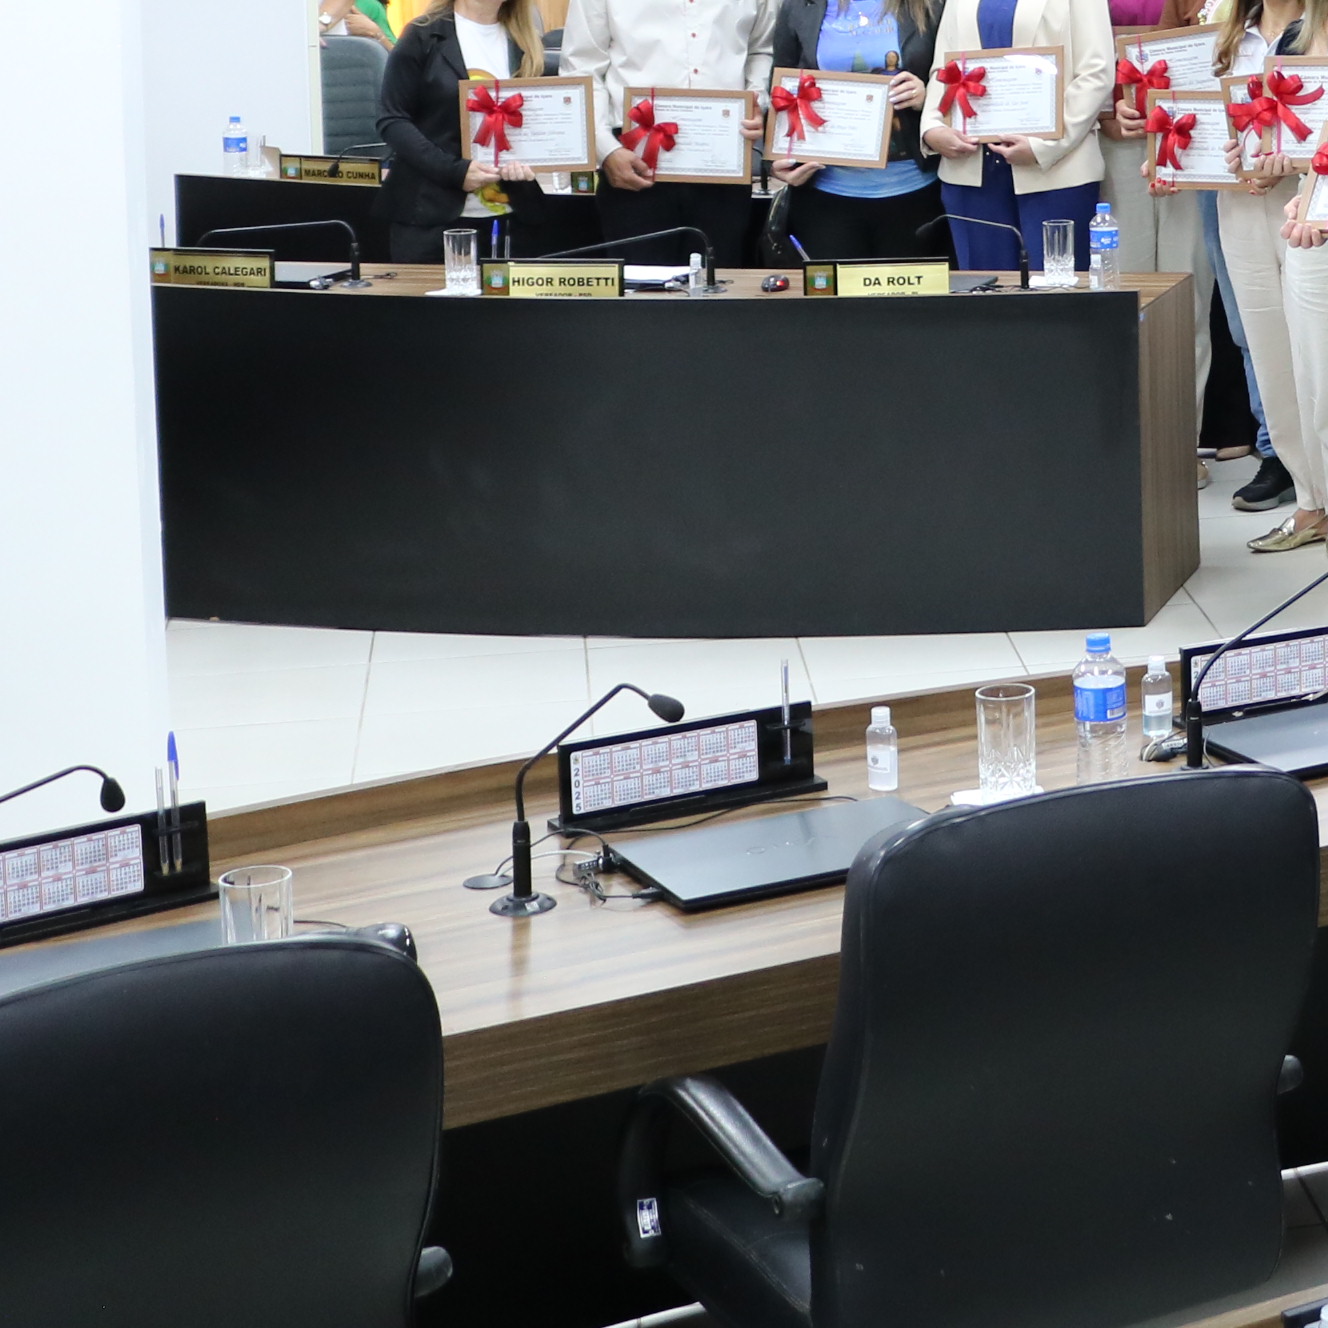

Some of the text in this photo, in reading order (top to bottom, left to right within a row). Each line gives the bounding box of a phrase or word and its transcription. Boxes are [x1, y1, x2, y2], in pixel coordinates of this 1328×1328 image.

[304, 168, 377, 181] MARCO CUNHA
[174, 265, 267, 277] KAROL CALEGARI
[512, 277, 615, 287] HIGOR ROBETTI
[863, 276, 923, 287] DA ROLT
[573, 767, 582, 812] 2025
